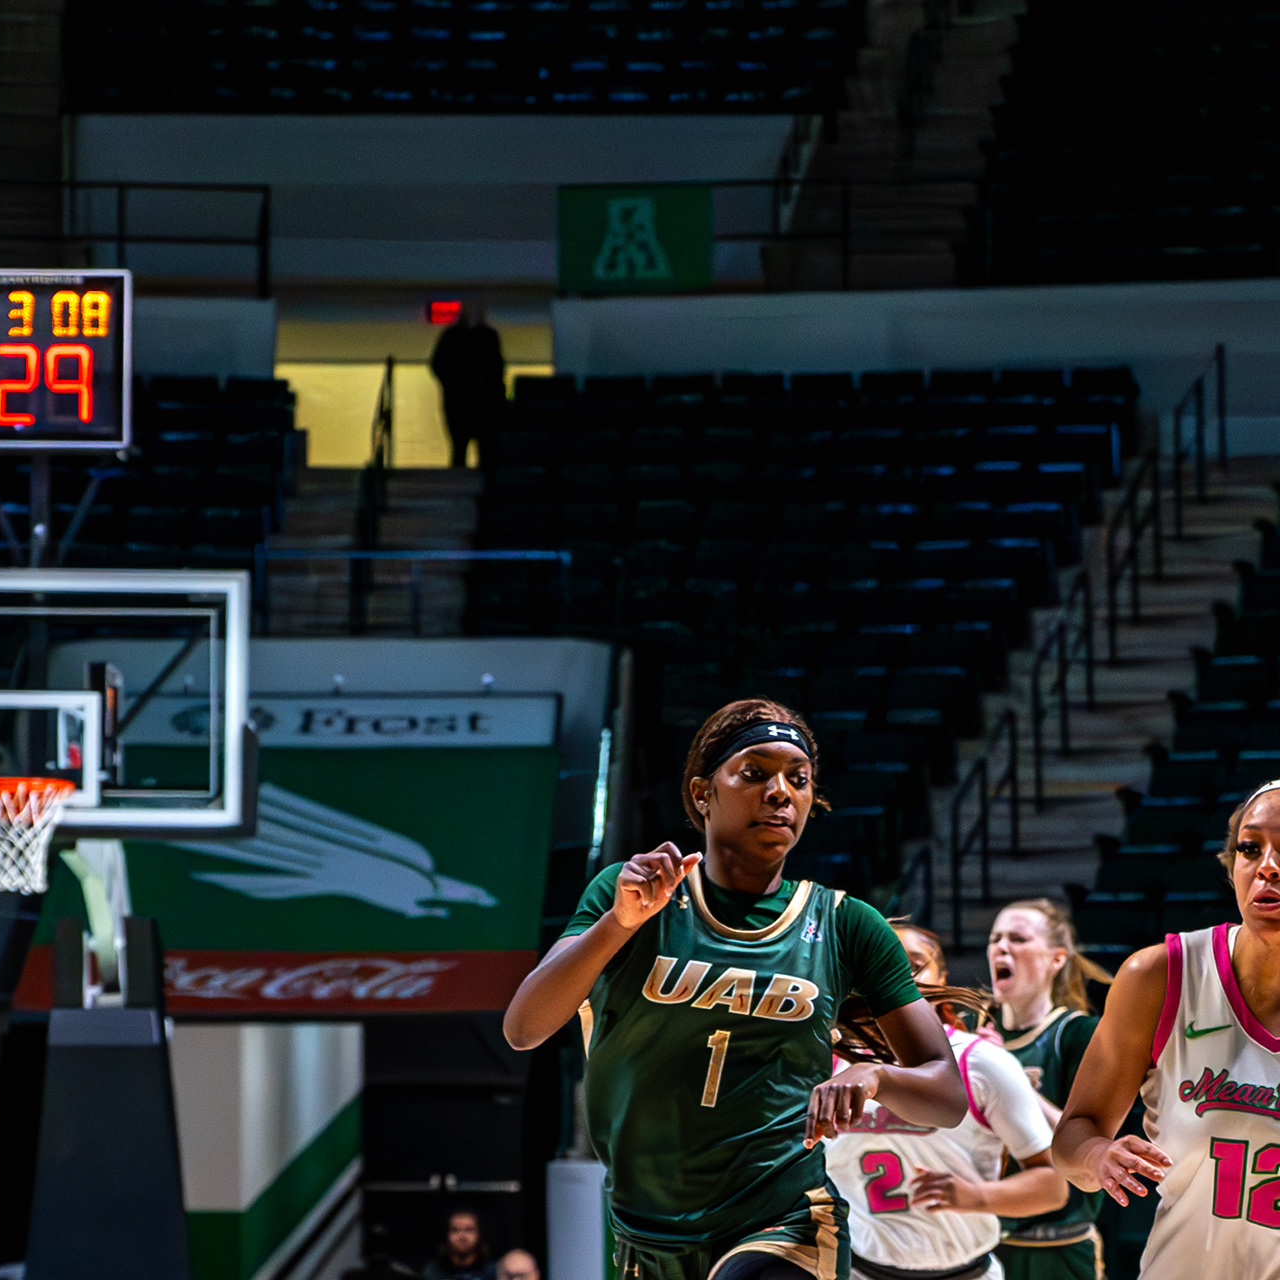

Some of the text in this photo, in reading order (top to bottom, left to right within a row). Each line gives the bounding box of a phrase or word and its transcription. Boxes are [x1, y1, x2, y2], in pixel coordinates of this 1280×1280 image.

[295, 708, 493, 737] Frost
[642, 955, 819, 1022] UAB
[700, 1029, 732, 1108] 1
[1179, 1067, 1277, 1106] Mean
[860, 1150, 910, 1214] 2
